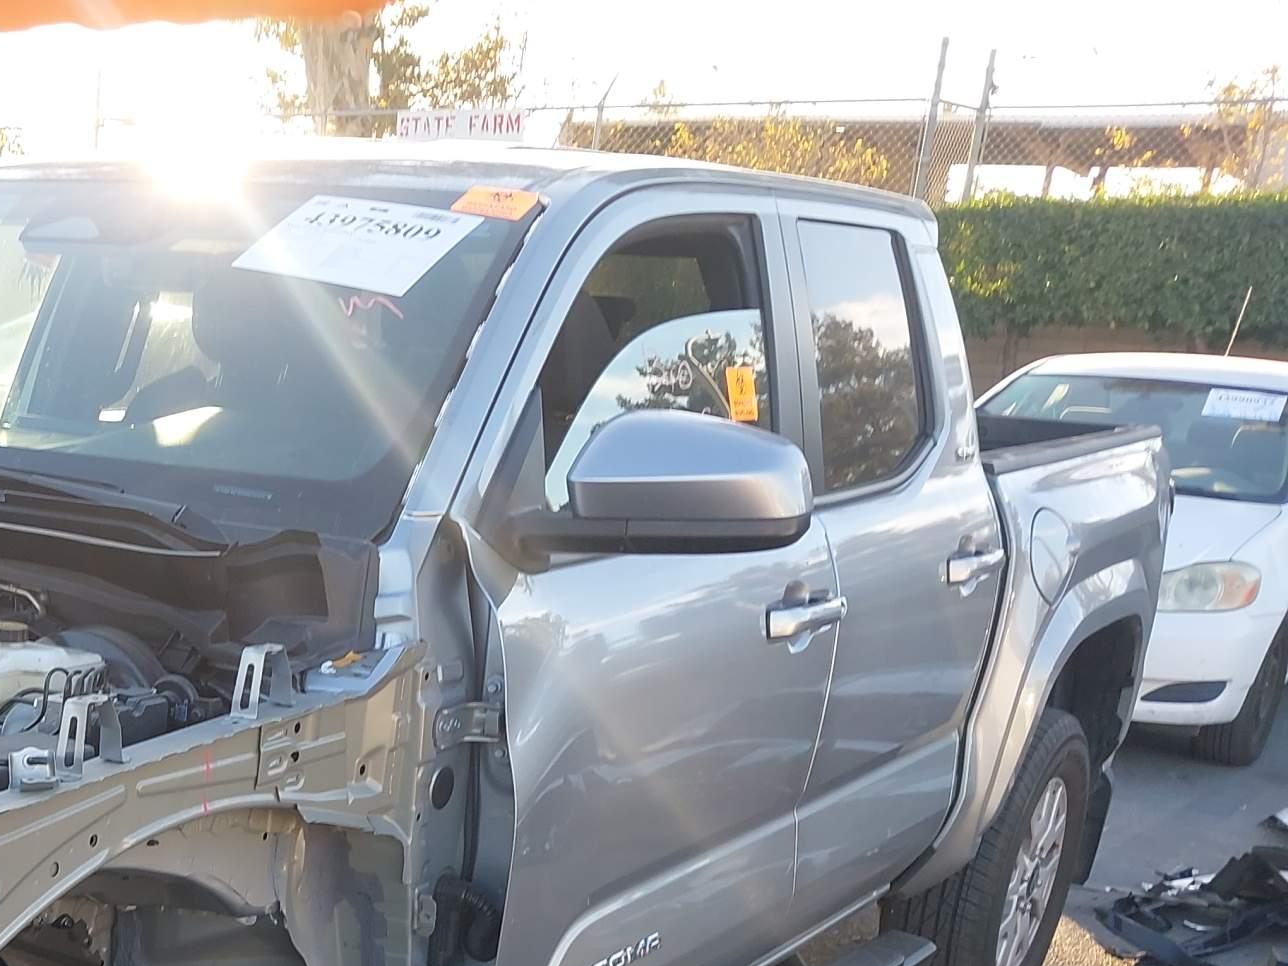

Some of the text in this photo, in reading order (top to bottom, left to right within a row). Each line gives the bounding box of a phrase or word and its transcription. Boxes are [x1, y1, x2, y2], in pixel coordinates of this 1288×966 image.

[399, 112, 521, 138] STATE FARM
[304, 211, 442, 240] 43975809
